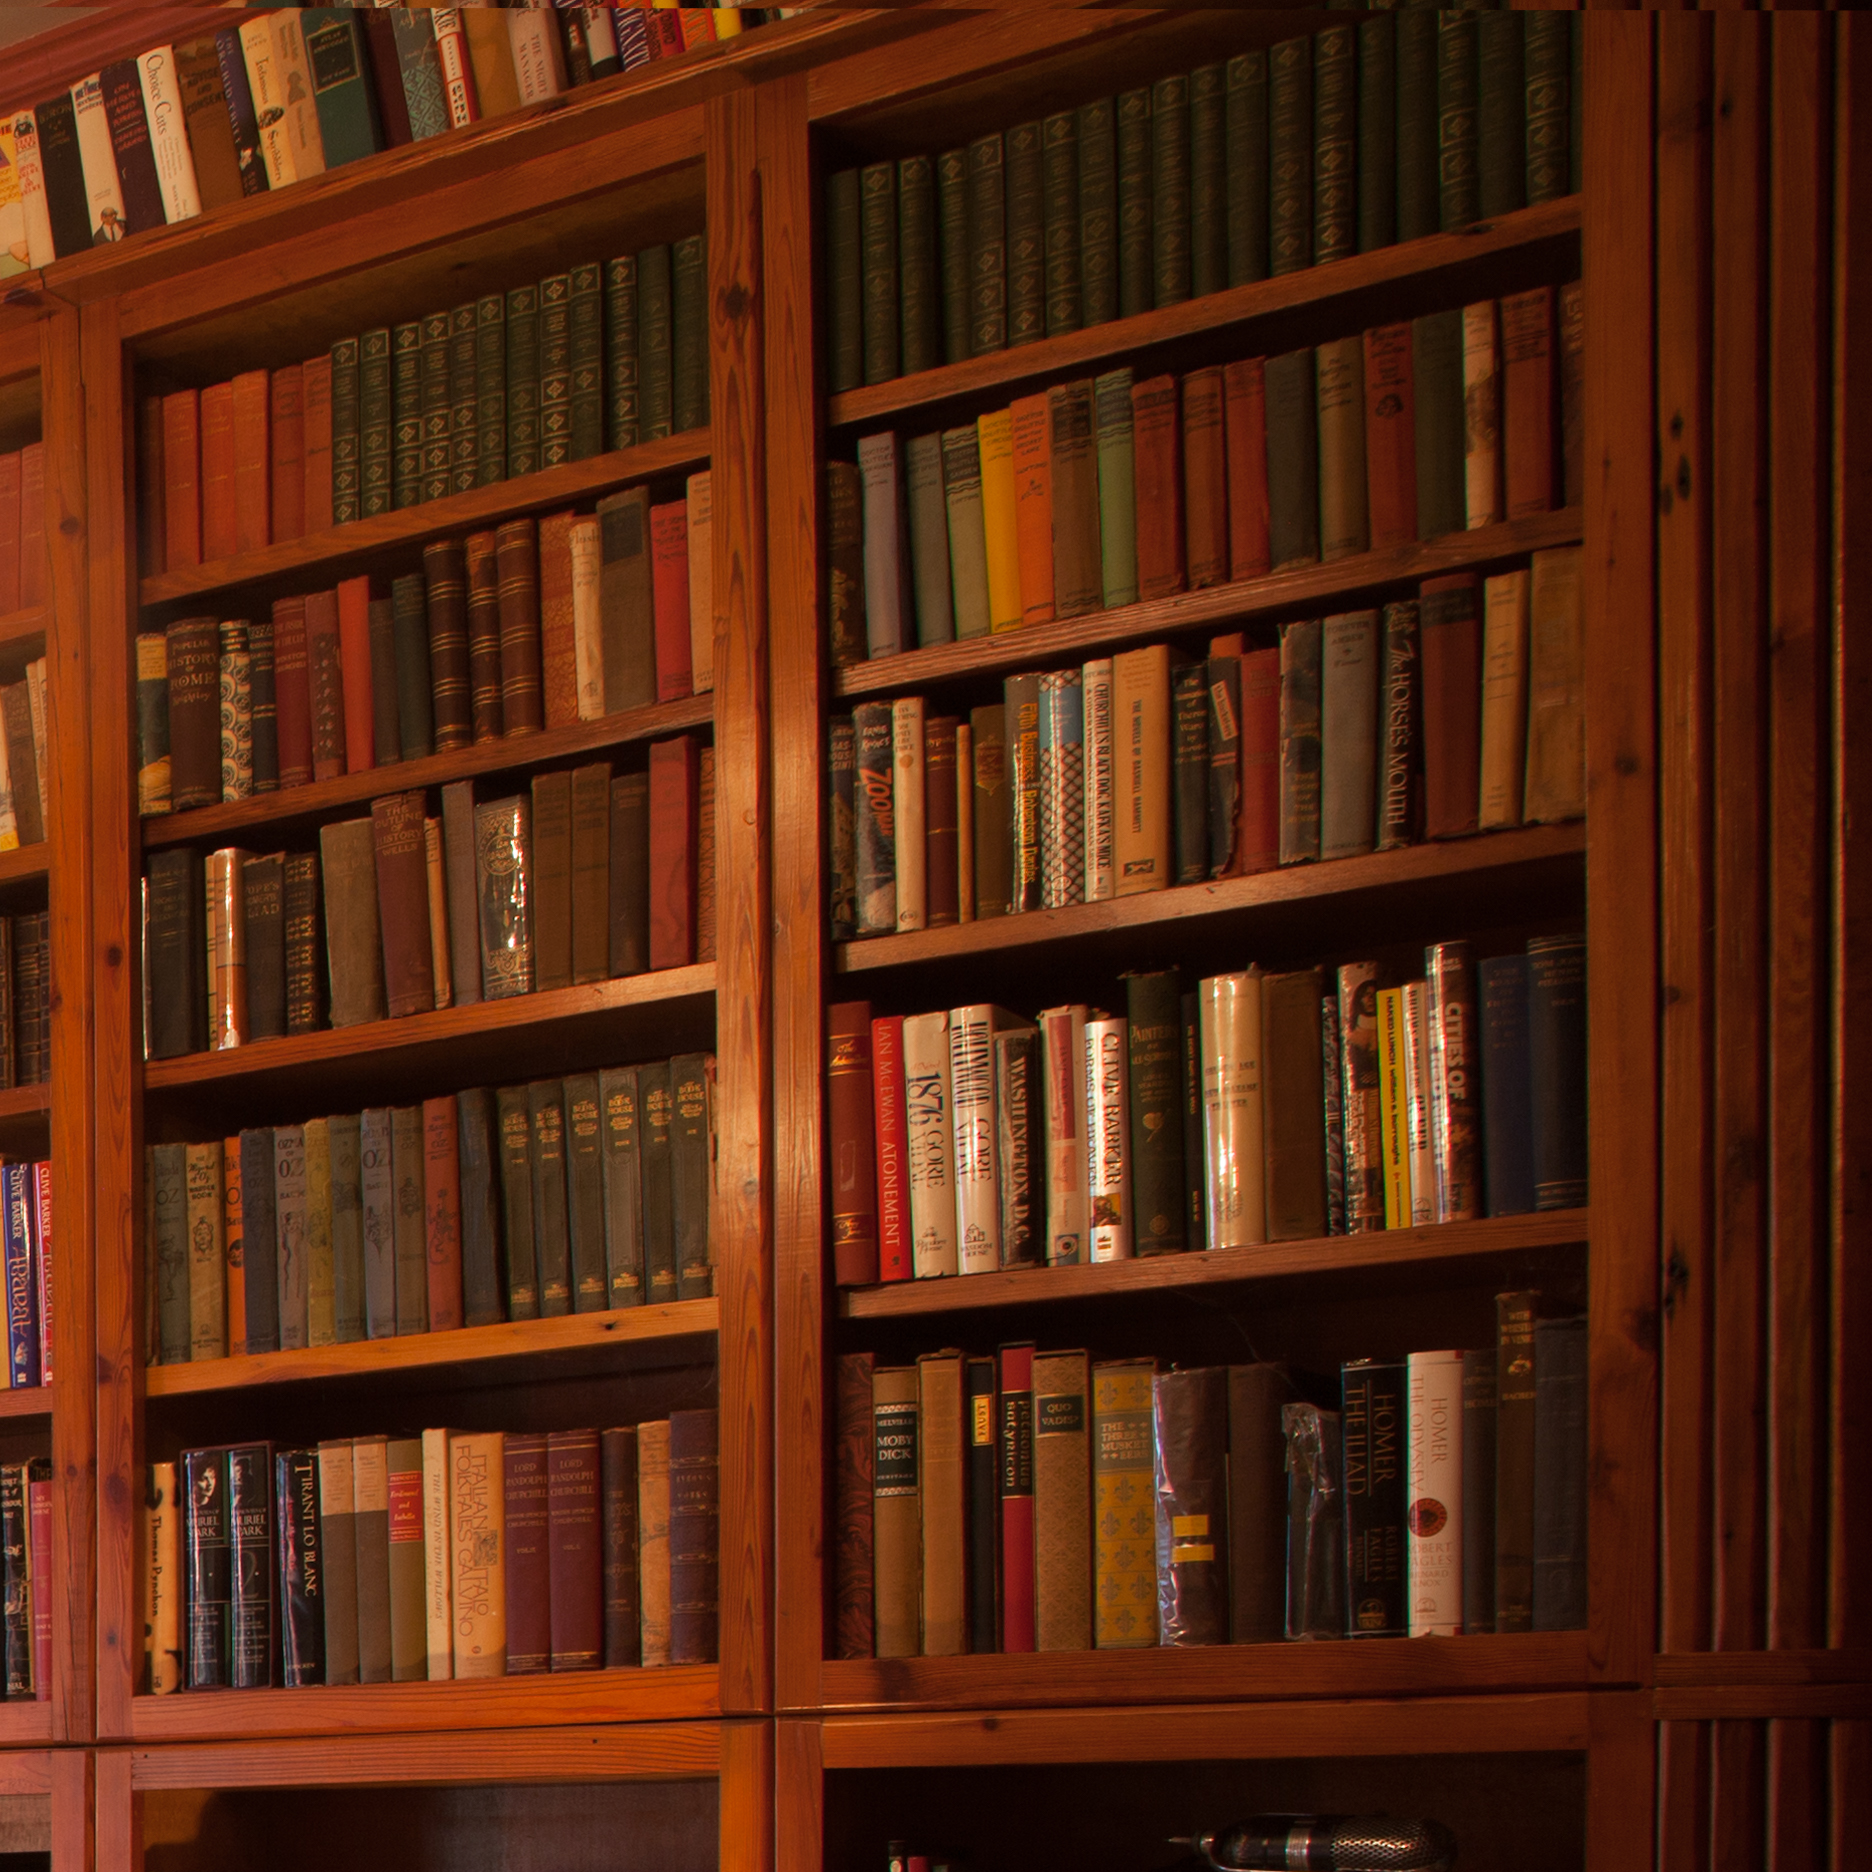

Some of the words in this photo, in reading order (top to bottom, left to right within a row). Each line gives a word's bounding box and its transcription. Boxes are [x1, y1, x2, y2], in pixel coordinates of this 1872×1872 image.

[145, 53, 169, 100] Choice
[151, 96, 169, 137] Cuts
[906, 1070, 943, 1127] 1876
[925, 1129, 946, 1189] GORE
[10, 1169, 20, 1199] CLIVE
[40, 1168, 50, 1199] CLIVE
[12, 1201, 22, 1240] BARKER
[41, 1200, 52, 1237] BARKER
[977, 1403, 986, 1437] FAUST
[1046, 1402, 1073, 1414] QUO
[1345, 1385, 1366, 1424] THE
[877, 1435, 914, 1447] MOBY
[1017, 1399, 1031, 1487] petronius
[1101, 1422, 1125, 1432] THE
[1101, 1431, 1136, 1441] THREE
[1101, 1441, 1148, 1452] MUSKET
[1373, 1393, 1396, 1484] HOMER
[1431, 1398, 1448, 1465] HOMER
[878, 1449, 912, 1461] DICK
[1345, 1434, 1366, 1496] ILIAD
[294, 1459, 316, 1527] TIRANT
[303, 1529, 315, 1547] LO
[303, 1550, 317, 1596] BLANC
[458, 1548, 474, 1637] CALVINO
